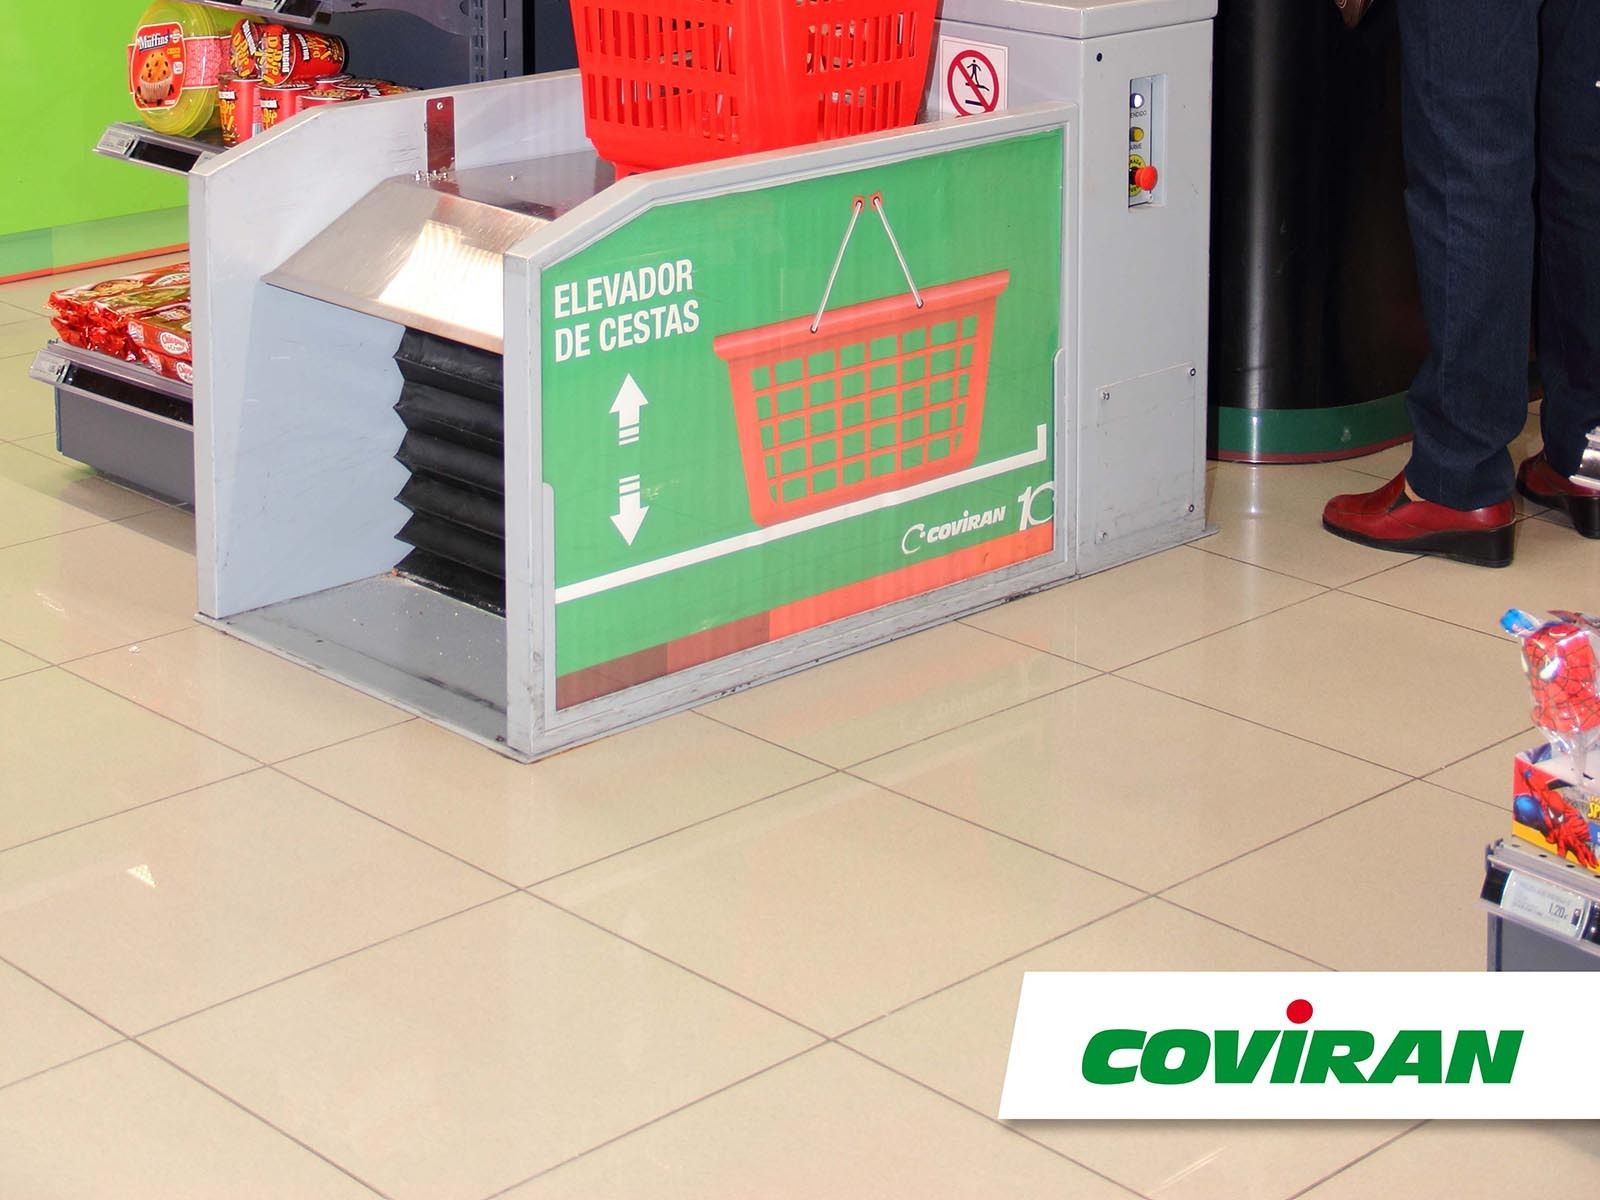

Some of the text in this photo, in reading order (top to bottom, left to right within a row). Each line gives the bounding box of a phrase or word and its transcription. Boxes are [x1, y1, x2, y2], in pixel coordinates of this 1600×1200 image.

[137, 32, 169, 50] Muffins
[554, 258, 694, 319] ELEVADOR
[555, 299, 700, 363] DE CESTAS
[926, 506, 1007, 544] COVIRAN
